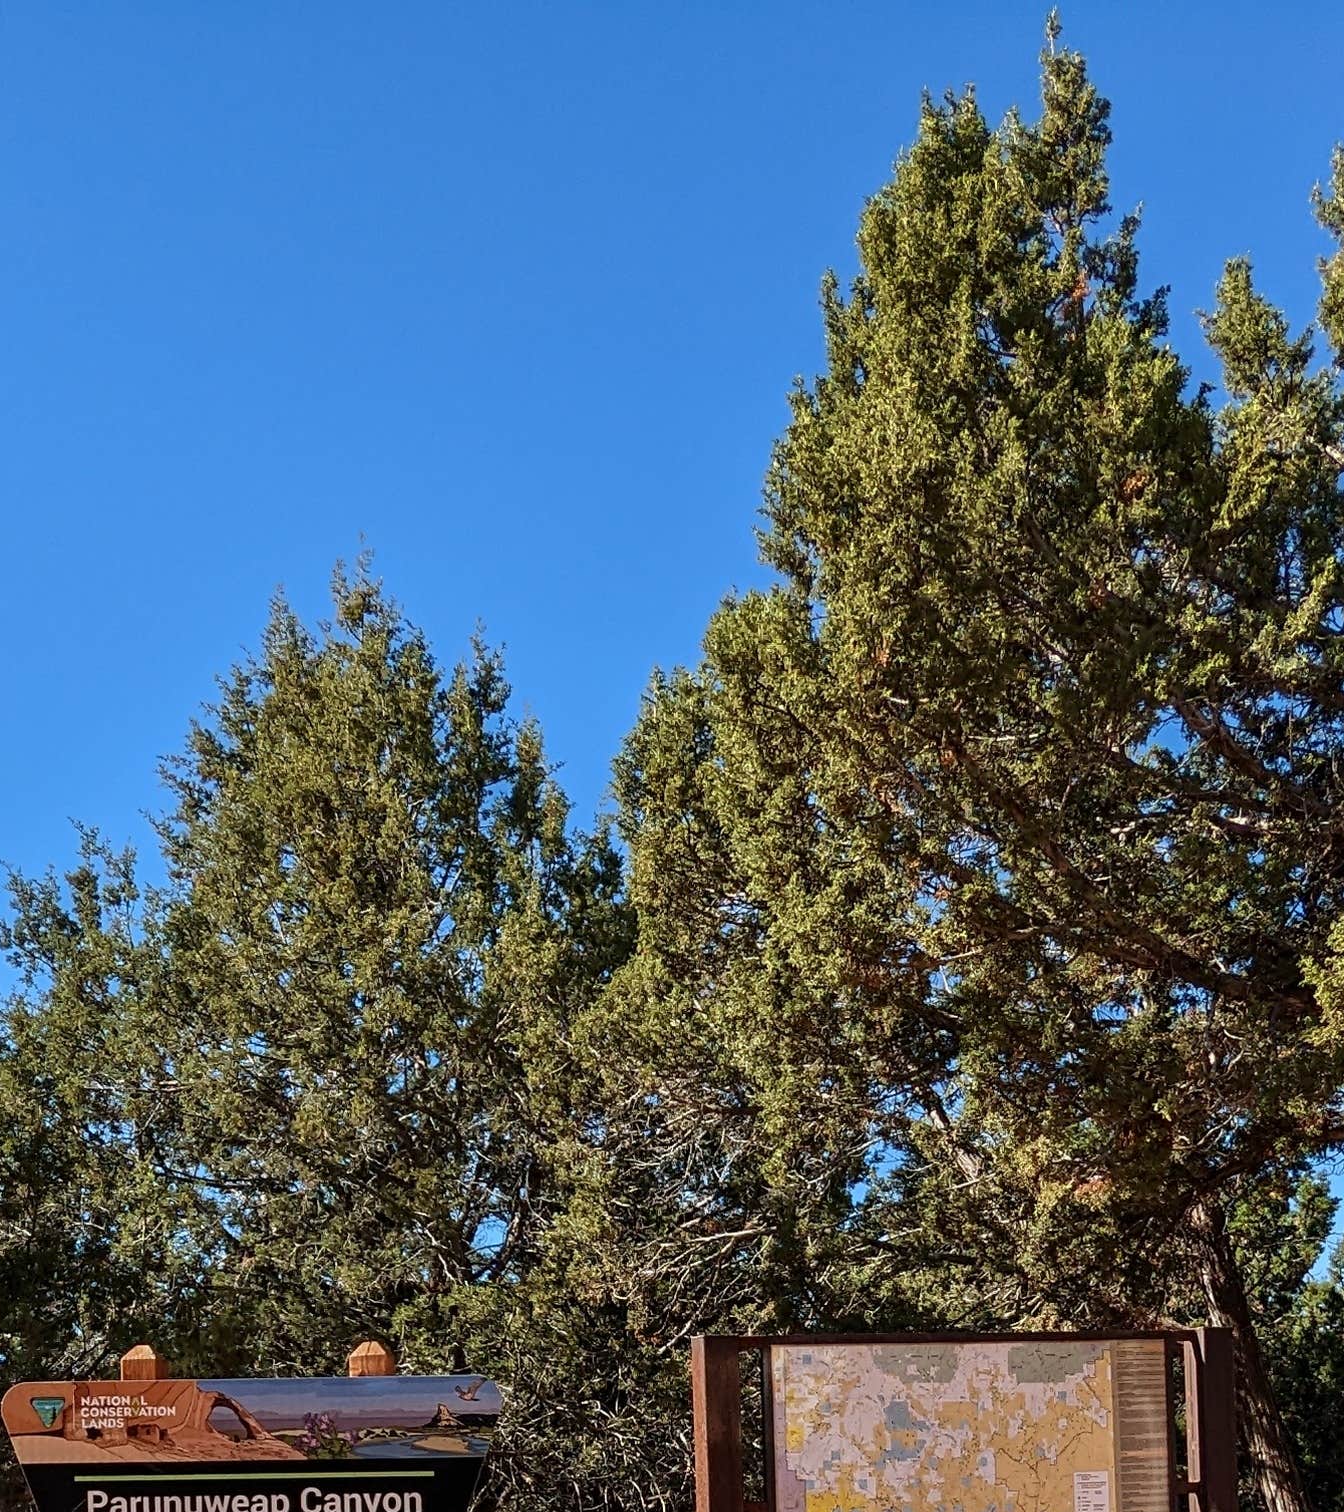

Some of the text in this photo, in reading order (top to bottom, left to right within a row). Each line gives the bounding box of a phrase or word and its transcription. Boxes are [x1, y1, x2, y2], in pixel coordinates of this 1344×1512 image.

[80, 1395, 147, 1406] NATIONAL
[80, 1406, 176, 1417] CONSERVATION
[81, 1418, 124, 1429] LANDS
